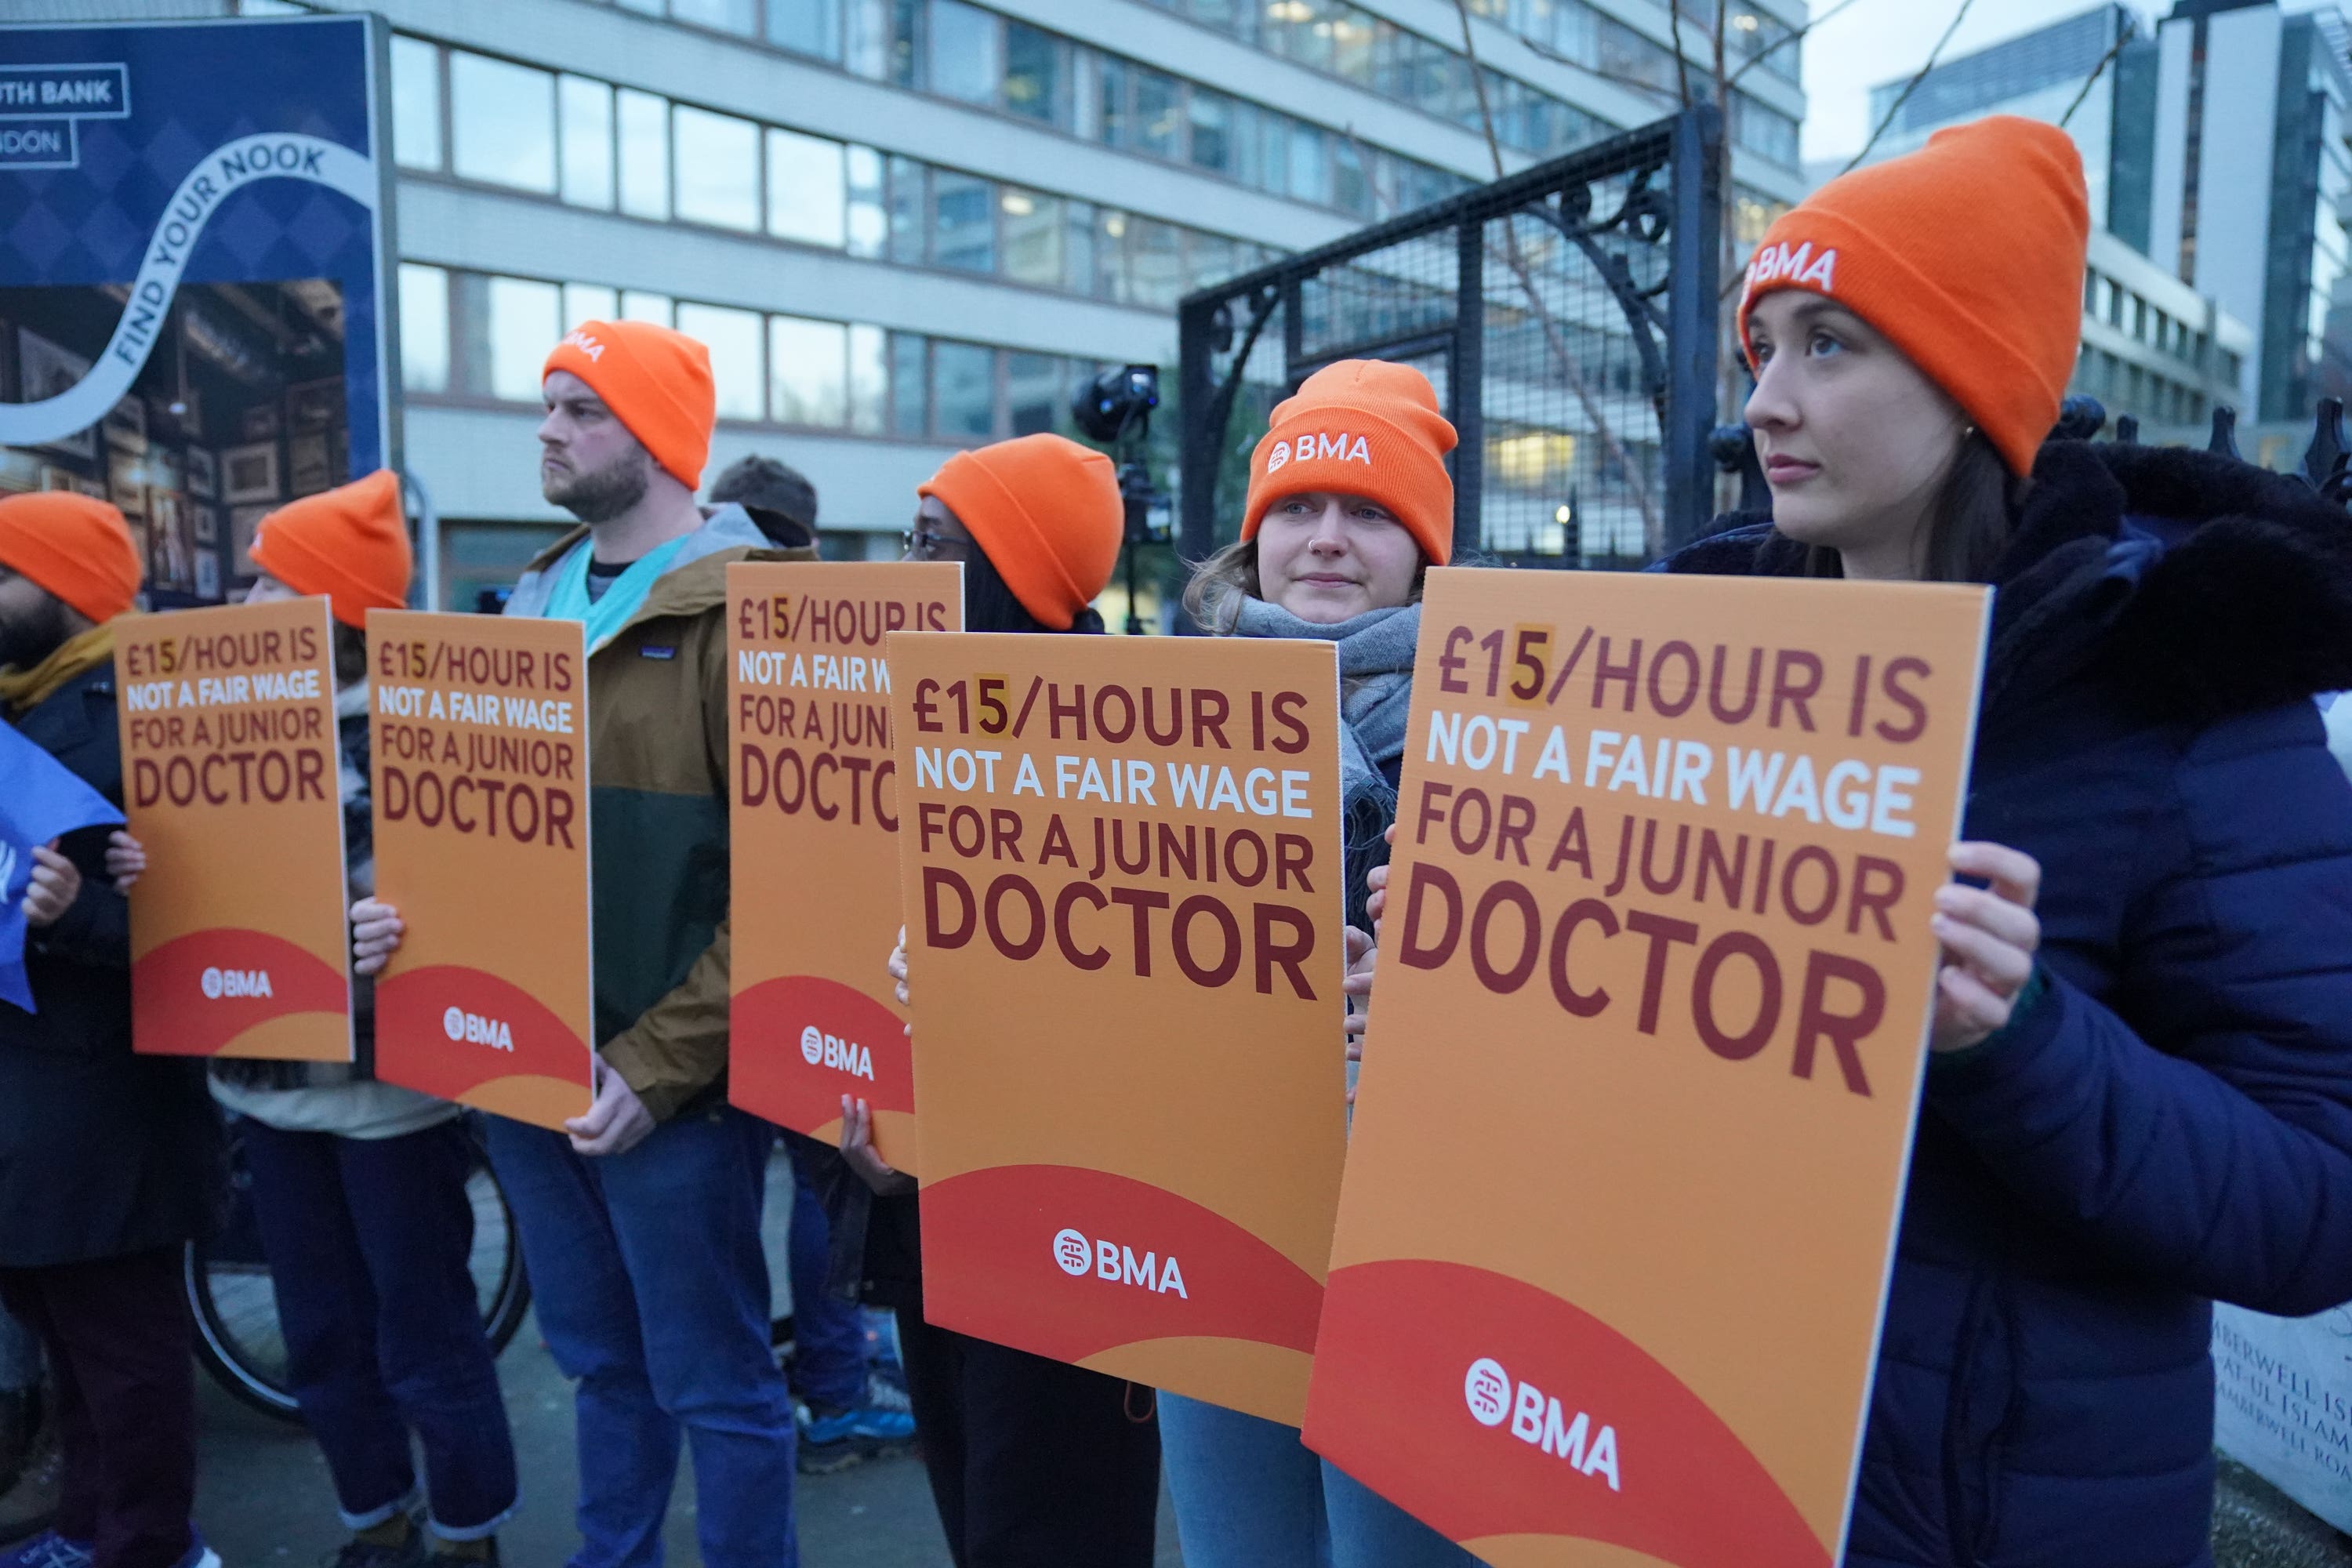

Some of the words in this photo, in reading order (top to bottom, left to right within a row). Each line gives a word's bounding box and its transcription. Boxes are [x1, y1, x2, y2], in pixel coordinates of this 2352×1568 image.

[0, 81, 36, 105] TH
[41, 79, 113, 104] BANK
[0, 129, 61, 154] DON
[115, 281, 165, 368] FIND
[156, 176, 220, 267] YOUR
[220, 143, 326, 183] NOOK
[1753, 241, 1837, 292] BMA
[1295, 432, 1371, 465] BMA
[126, 631, 280, 677] £15/HOUR
[290, 626, 318, 662] IS
[379, 640, 534, 688] £15/HOUR
[544, 649, 572, 692] IS
[739, 649, 786, 685] NOT
[790, 653, 808, 688] A
[813, 654, 866, 693] FAIR
[127, 681, 172, 712] NOT
[177, 679, 195, 707] A
[199, 674, 250, 706] FAIR
[255, 670, 321, 702] WAGE
[378, 684, 423, 719] NOT
[428, 692, 447, 720] A
[449, 691, 499, 727] FAIR
[503, 695, 574, 735] WAGE
[1438, 626, 1824, 732] £15/HOUR
[1847, 655, 1933, 743] IS
[130, 715, 184, 750] FOR
[192, 714, 210, 746] A
[217, 707, 322, 750] JUNIOR
[740, 694, 795, 739] FOR
[803, 700, 824, 742] A
[829, 702, 893, 750] JUN
[913, 675, 1232, 749] £15/HOUR
[1251, 690, 1310, 754] IS
[133, 748, 325, 808] DOCTOR
[380, 724, 434, 762] FOR
[441, 731, 460, 764] A
[466, 732, 575, 781] JUNIOR
[1425, 710, 1529, 775] NOT
[1533, 725, 1571, 784] A
[1584, 729, 1712, 805] FAIR
[1725, 746, 1922, 837] WAGE
[382, 765, 575, 850] DOCTOR
[741, 743, 898, 833] DOCTO
[914, 746, 1001, 793] NOT
[1013, 753, 1044, 797] A
[1056, 755, 1157, 806] FAIR
[1167, 762, 1312, 818] WAGE
[919, 802, 1025, 862] FOR
[1039, 814, 1078, 868] A
[1089, 817, 1316, 893] JUNIOR
[1416, 780, 1536, 867] FOR
[1546, 805, 1593, 880] A
[1604, 813, 1906, 942] JUNIOR
[922, 866, 1318, 1001] DOCTOR
[224, 969, 273, 998] BMA
[1399, 861, 1887, 1098] DOCTOR
[465, 1011, 514, 1053] BMA
[824, 1033, 875, 1081] BMA
[1098, 1240, 1188, 1299] BMA
[1510, 1380, 1621, 1491] BMA
[2282, 1394, 2350, 1454] ISLAM
[2325, 1391, 2352, 1427] IS
[2313, 1445, 2352, 1483] ROA
